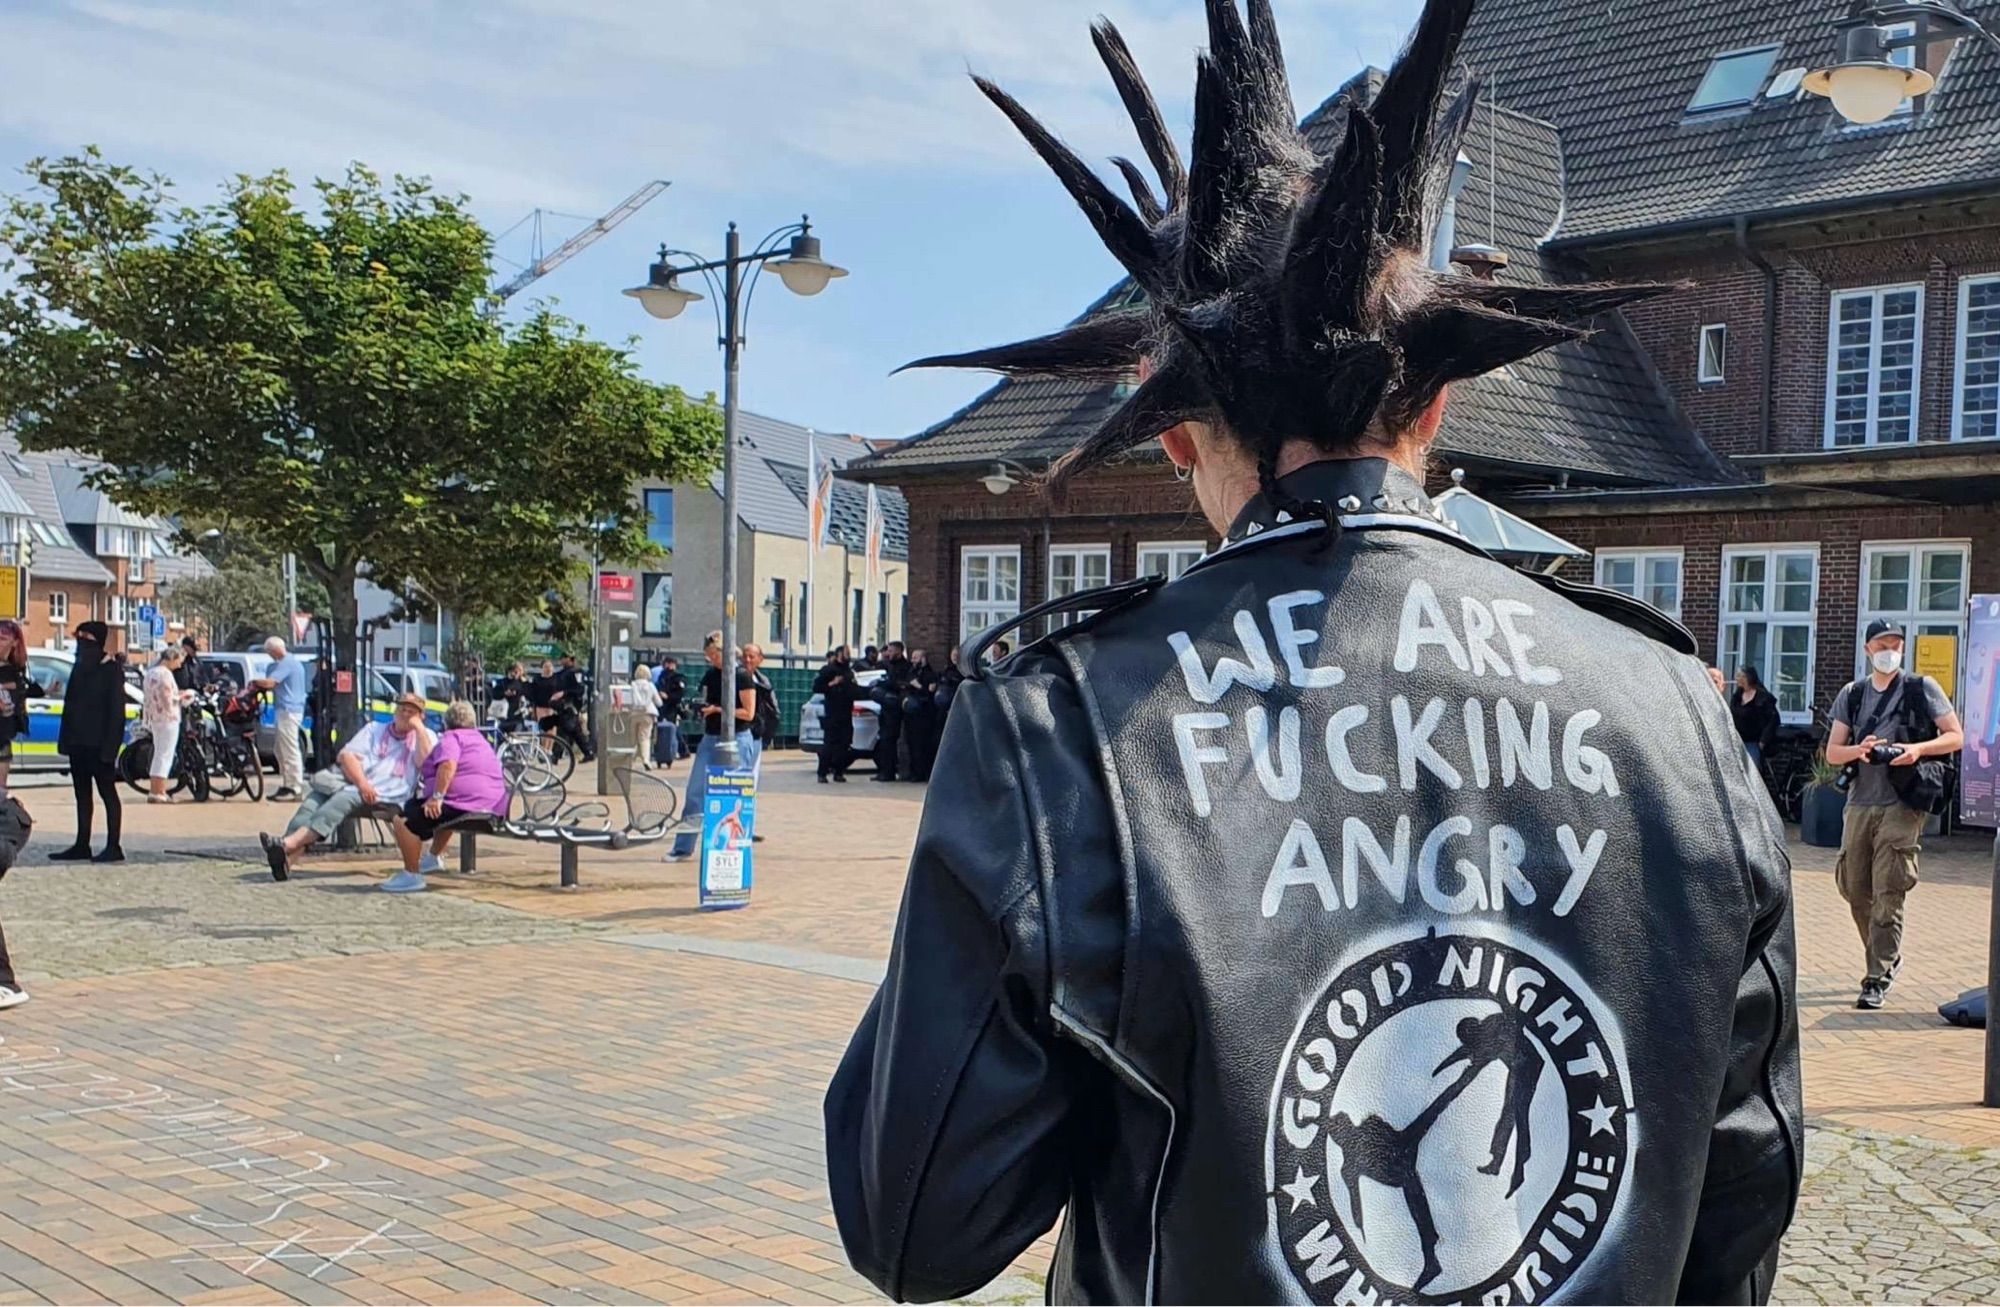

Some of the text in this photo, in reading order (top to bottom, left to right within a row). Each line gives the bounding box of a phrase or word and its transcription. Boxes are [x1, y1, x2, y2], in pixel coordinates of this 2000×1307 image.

[1167, 579, 1563, 704] WE ARE
[1172, 695, 1621, 818] FUCKING
[1262, 814, 1608, 918] ANGRY
[1282, 944, 1609, 1149] GOOD NIGHT
